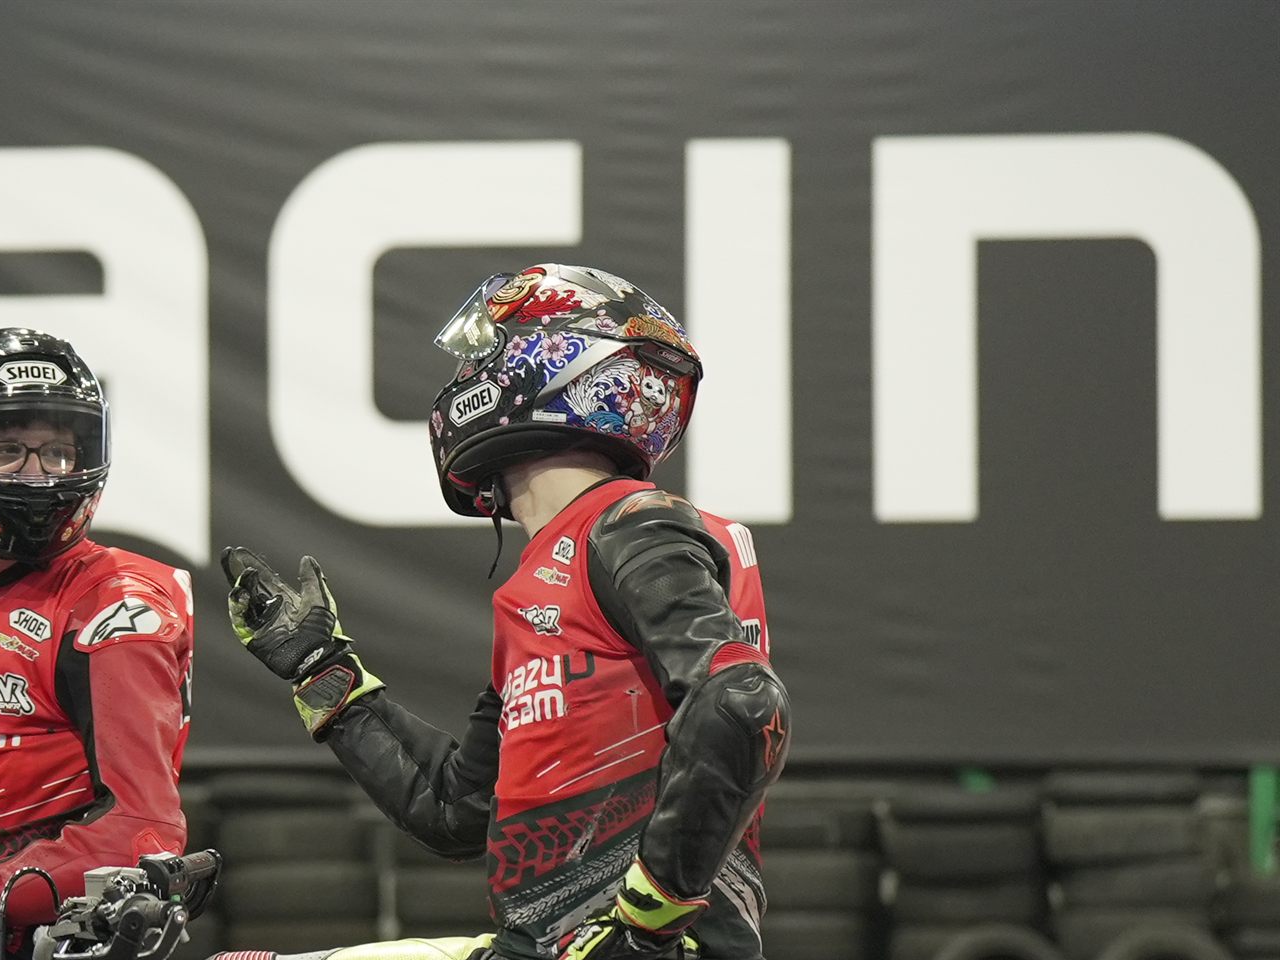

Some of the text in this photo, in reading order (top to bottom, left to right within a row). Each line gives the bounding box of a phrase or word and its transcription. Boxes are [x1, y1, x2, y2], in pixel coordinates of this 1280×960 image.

[6, 365, 57, 381] SHOEI
[454, 387, 493, 420] SHOEI
[13, 611, 48, 639] SHOEI
